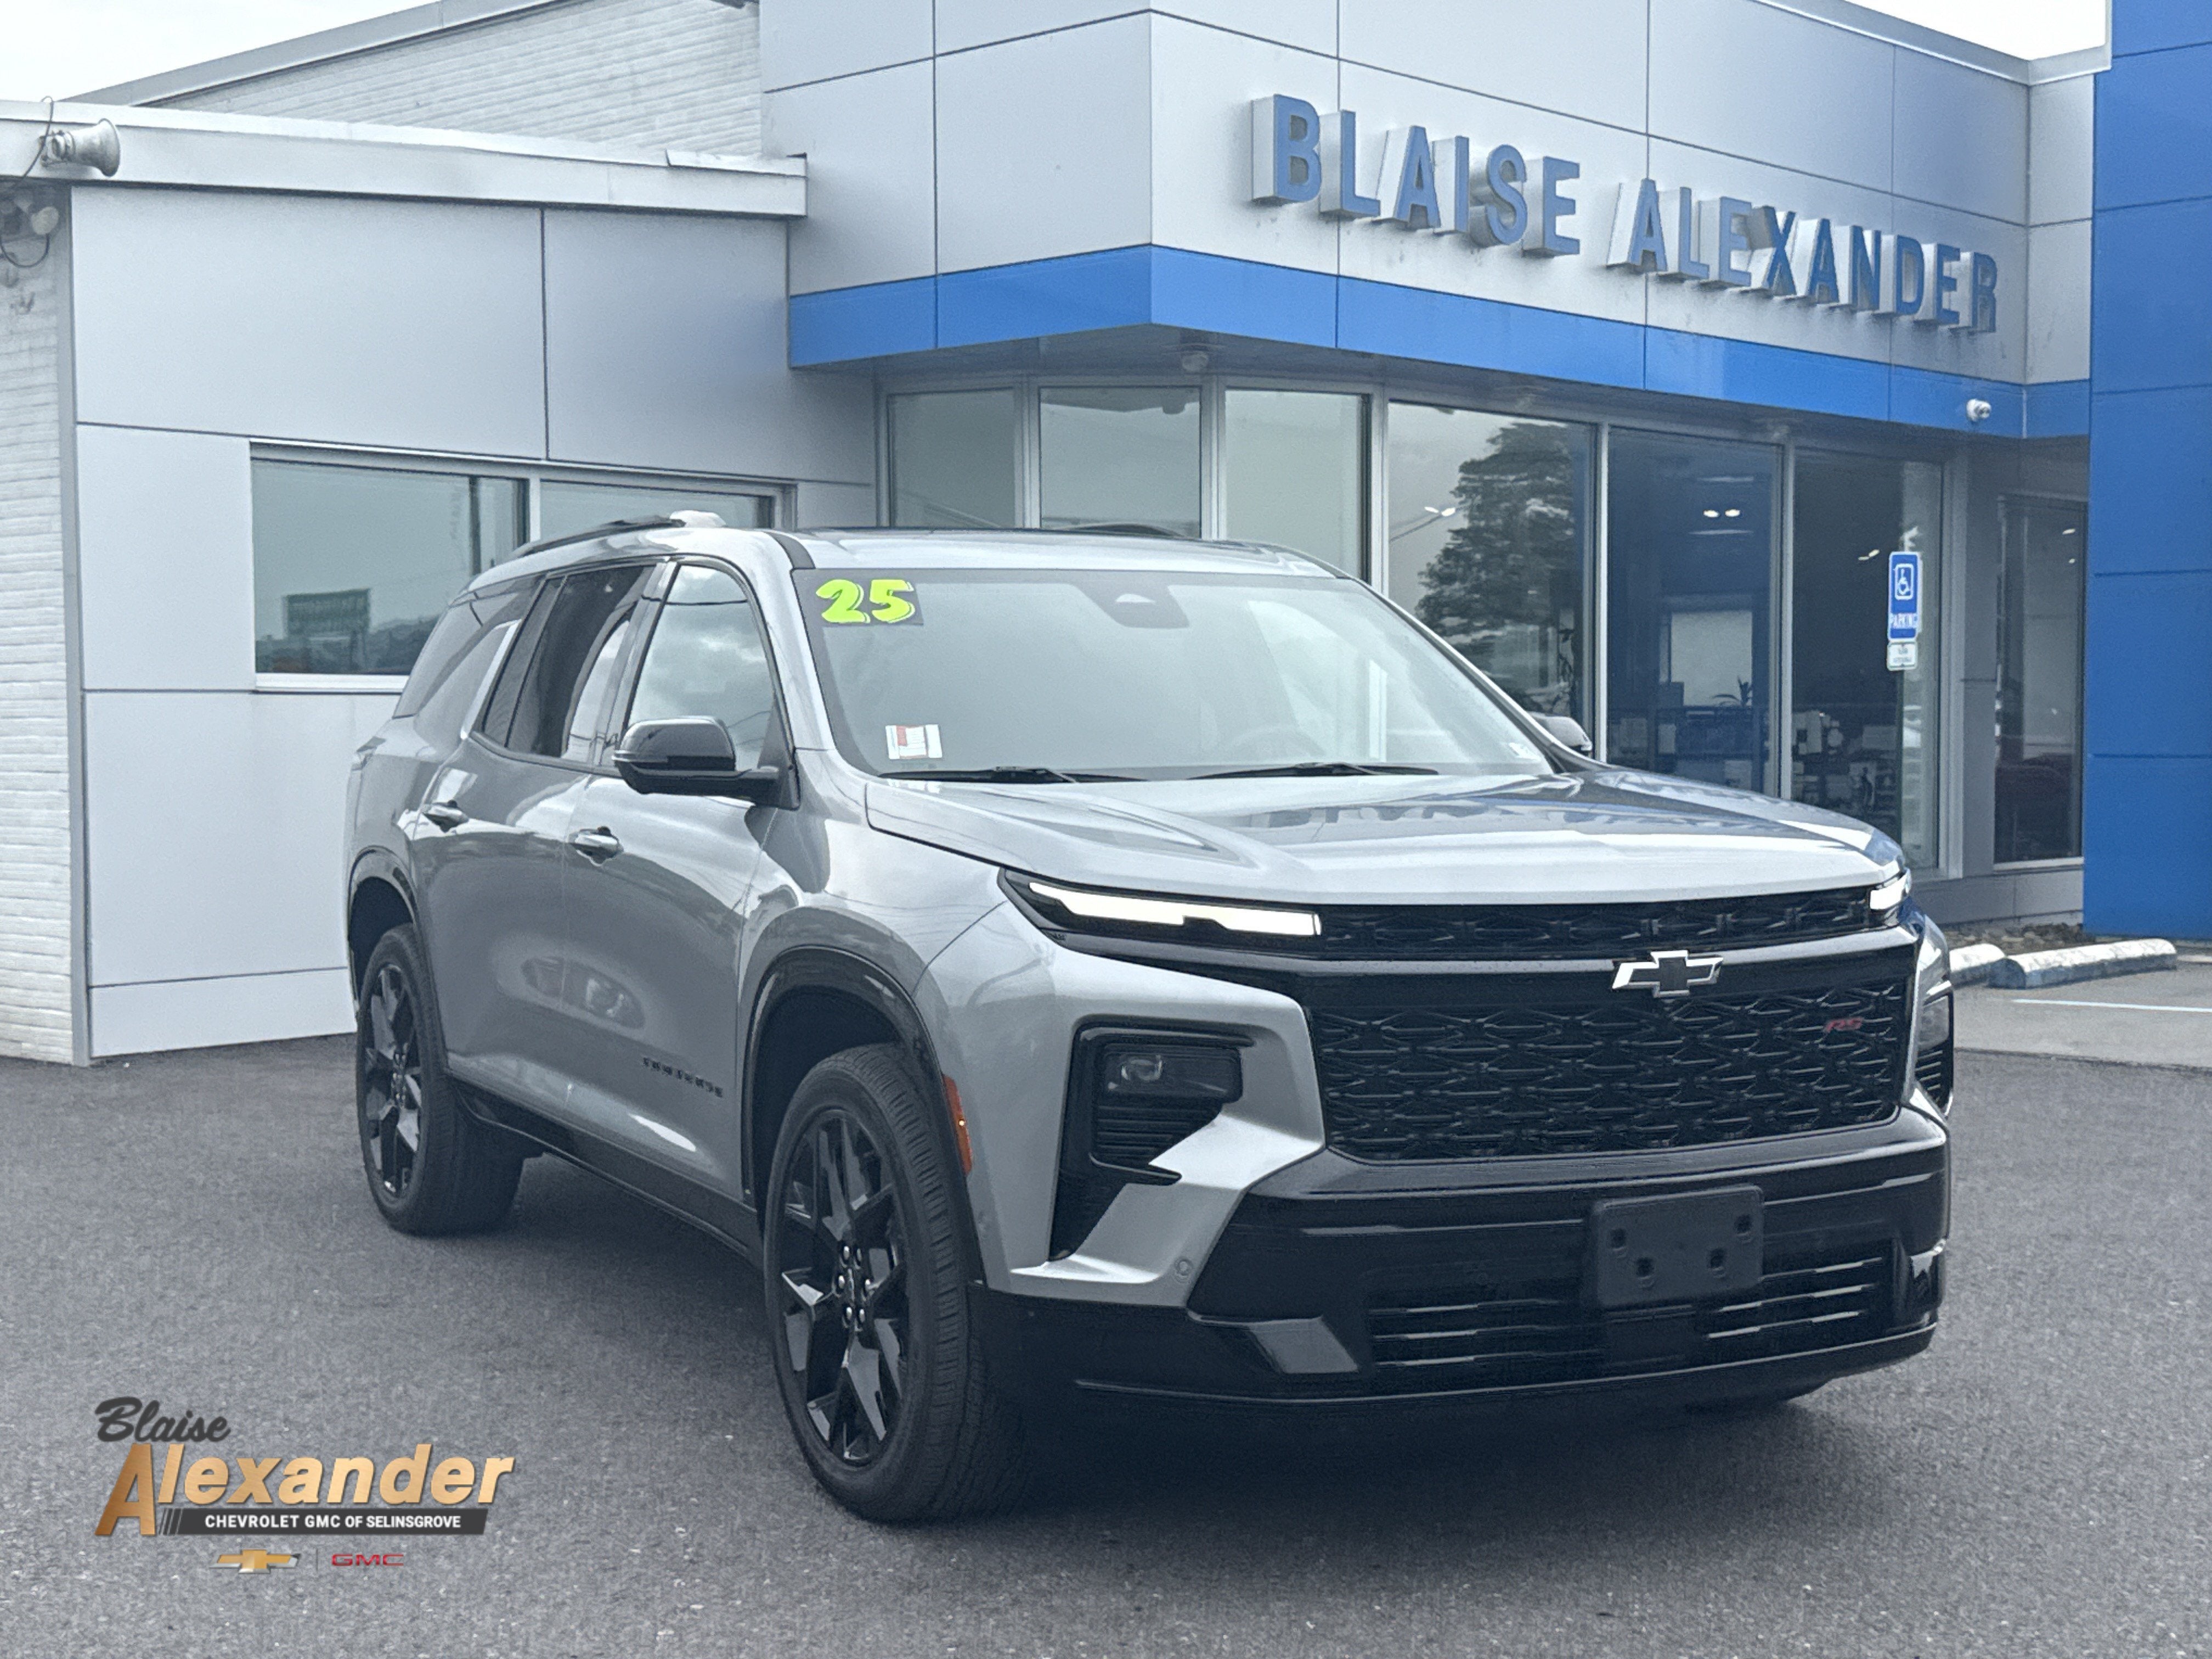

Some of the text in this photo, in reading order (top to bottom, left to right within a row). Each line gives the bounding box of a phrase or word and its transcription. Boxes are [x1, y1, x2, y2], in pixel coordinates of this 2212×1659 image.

[1267, 94, 1999, 332] BLAISE ALEXANDER
[815, 578, 916, 624] 25
